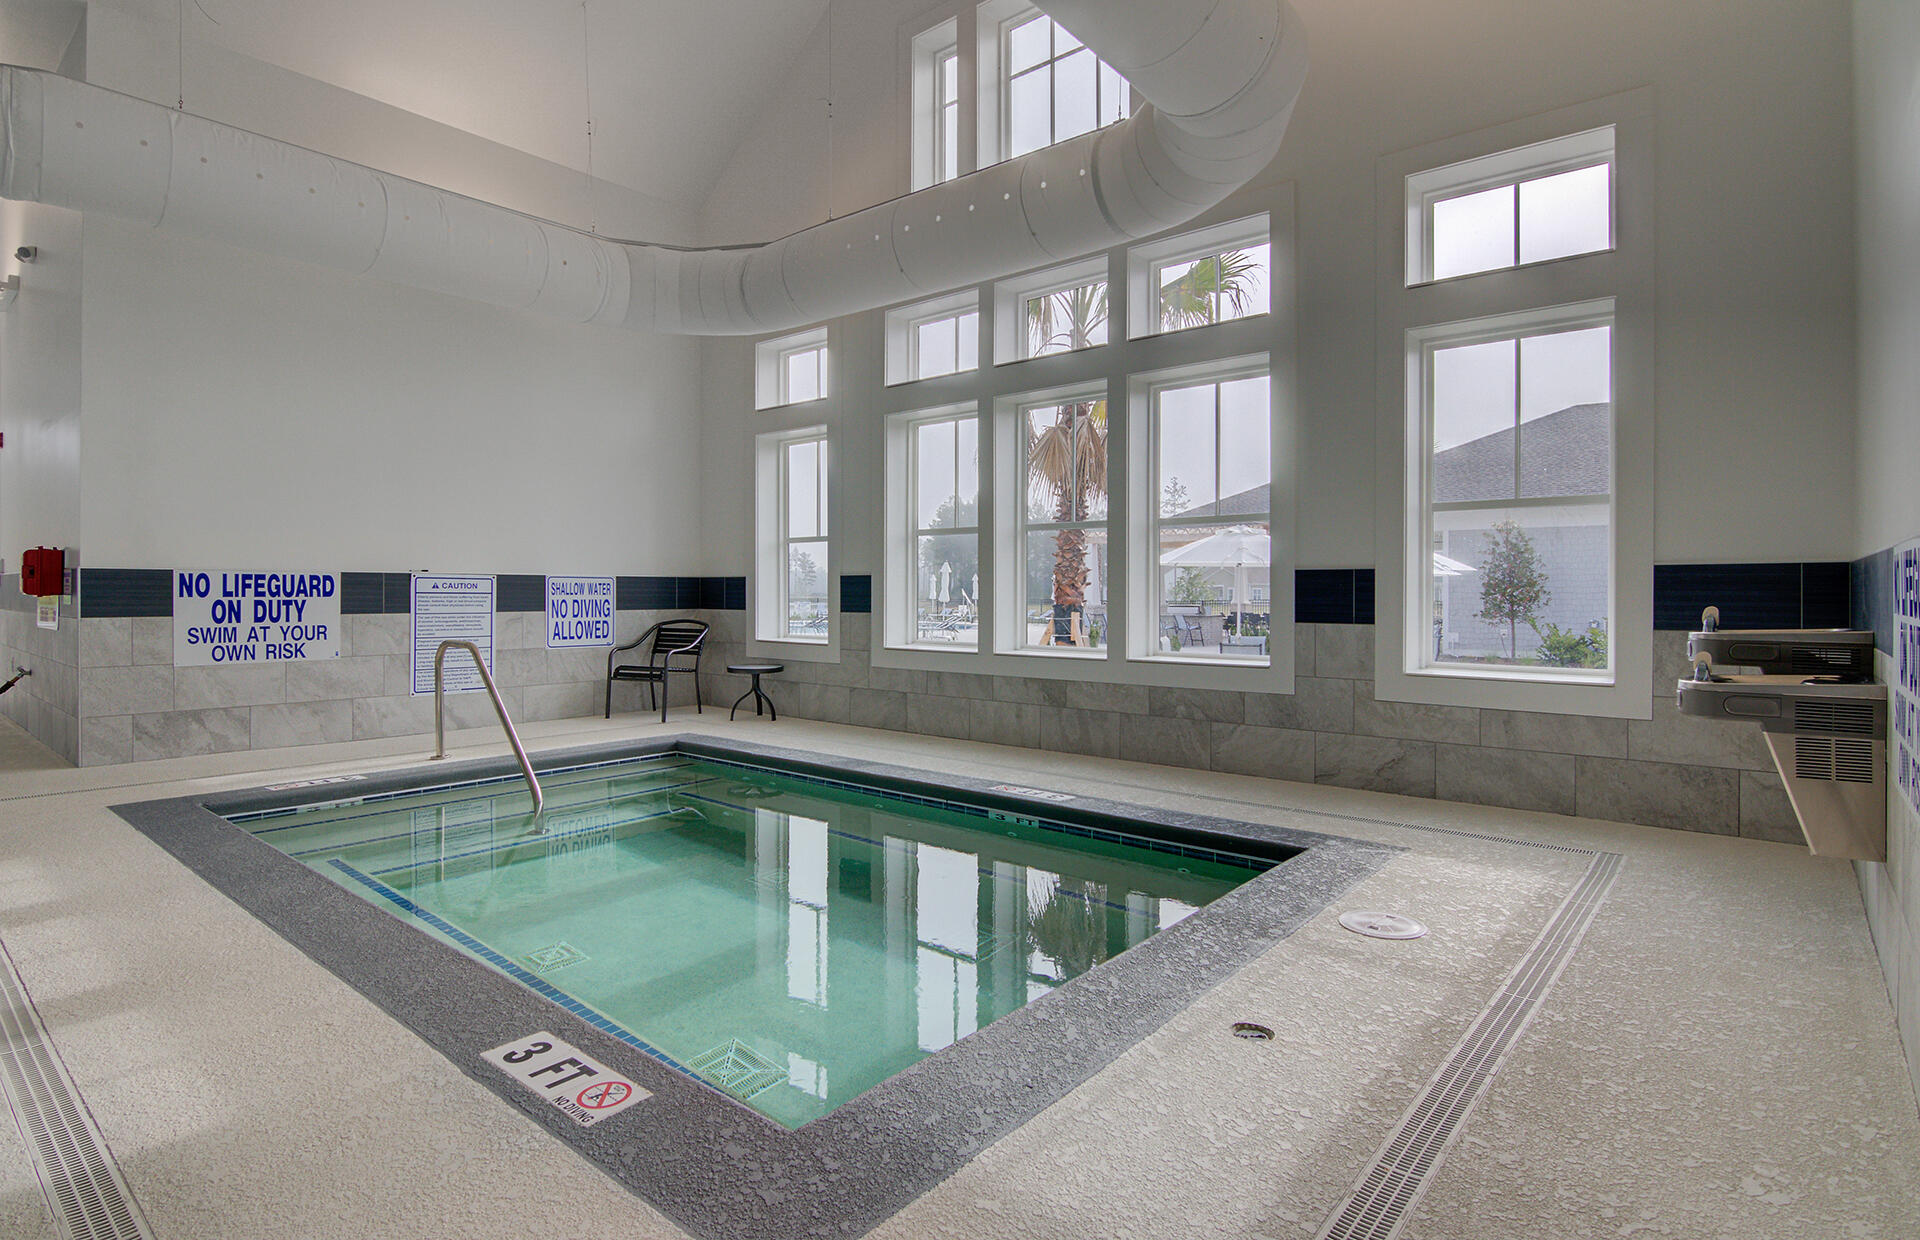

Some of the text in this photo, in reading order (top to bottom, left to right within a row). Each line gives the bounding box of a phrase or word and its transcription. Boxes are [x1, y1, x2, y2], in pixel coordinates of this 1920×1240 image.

[178, 573, 335, 598] NO LIFEGUARD
[441, 582, 478, 590] CAUTION
[551, 582, 611, 595] SHALLOW WATER
[211, 599, 307, 624] ON DUTY
[551, 599, 611, 619] NO DIVING
[187, 625, 328, 644] SWIM AT YOUR
[552, 620, 610, 640] ALLOWED
[211, 642, 306, 662] OWN RISK
[1016, 817, 1035, 825] FT
[503, 1041, 599, 1089] 3 FT
[552, 1095, 594, 1123] NO DIVING
